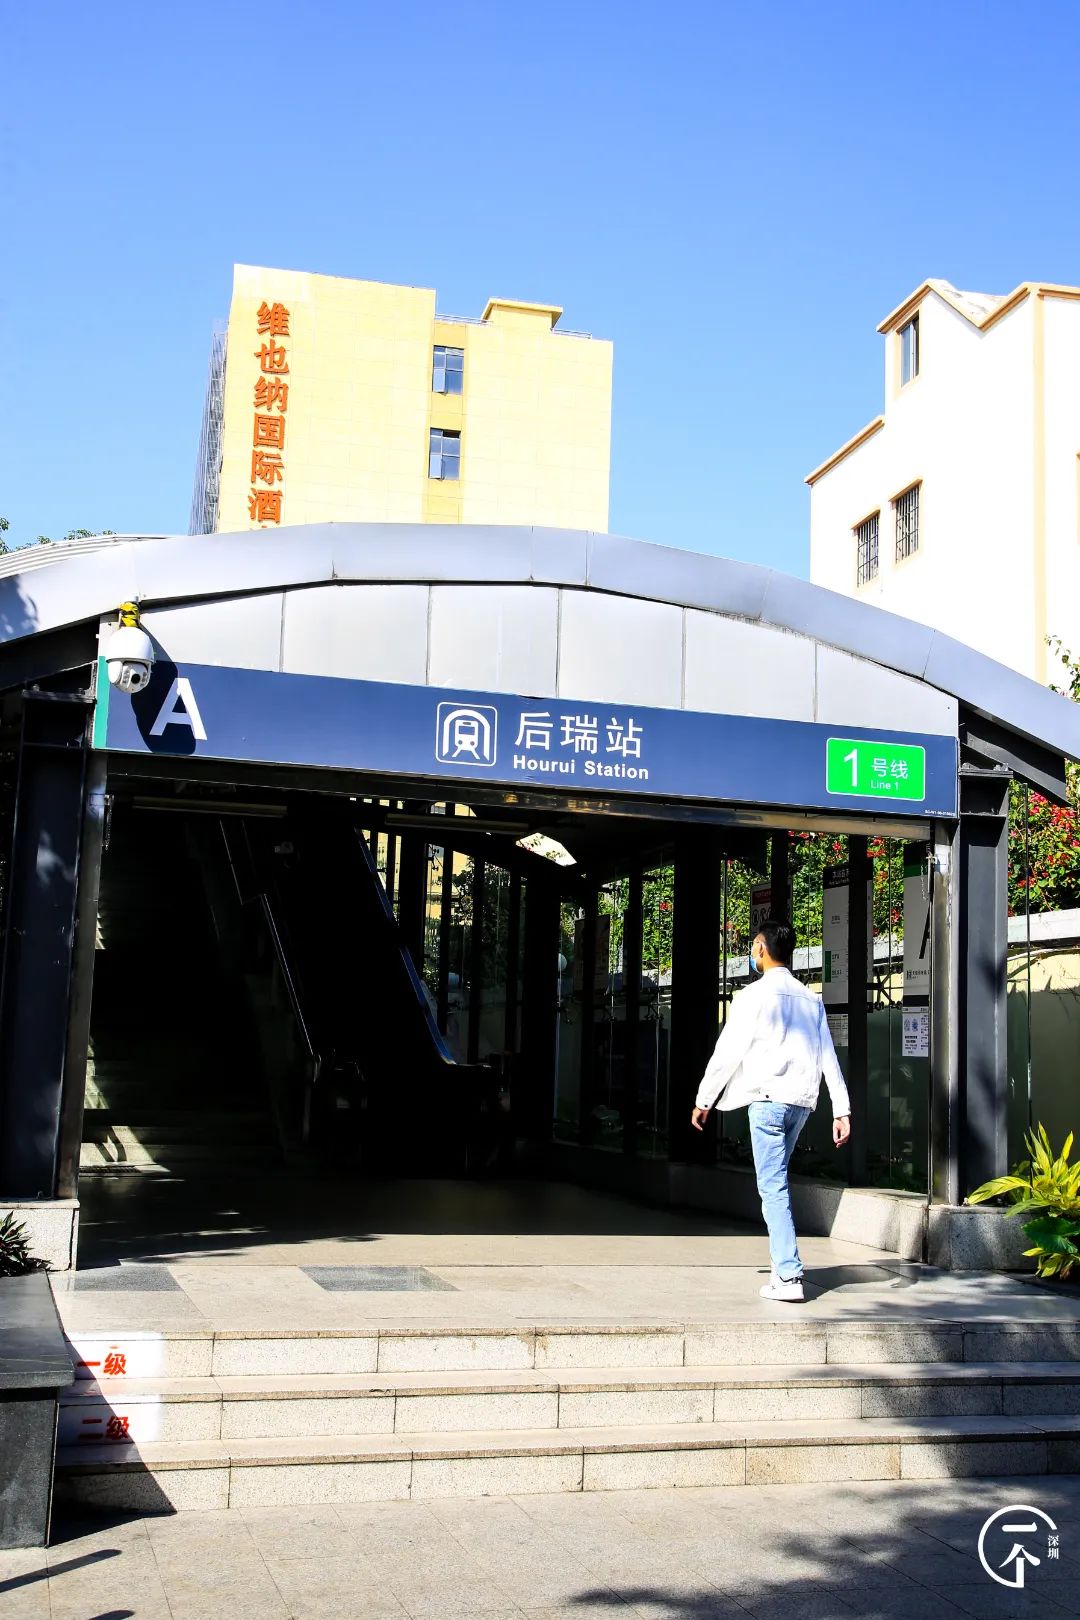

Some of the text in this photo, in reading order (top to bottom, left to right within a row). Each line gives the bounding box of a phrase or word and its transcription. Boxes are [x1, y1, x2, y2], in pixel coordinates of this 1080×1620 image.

[247, 301, 291, 528] 维也纳国际酒
[149, 678, 207, 740] A
[514, 712, 643, 758] 后瑞站
[513, 754, 649, 780] Hourui Station
[870, 779, 899, 790] Line 1
[77, 1352, 127, 1375] 一级
[78, 1415, 129, 1440] 二级
